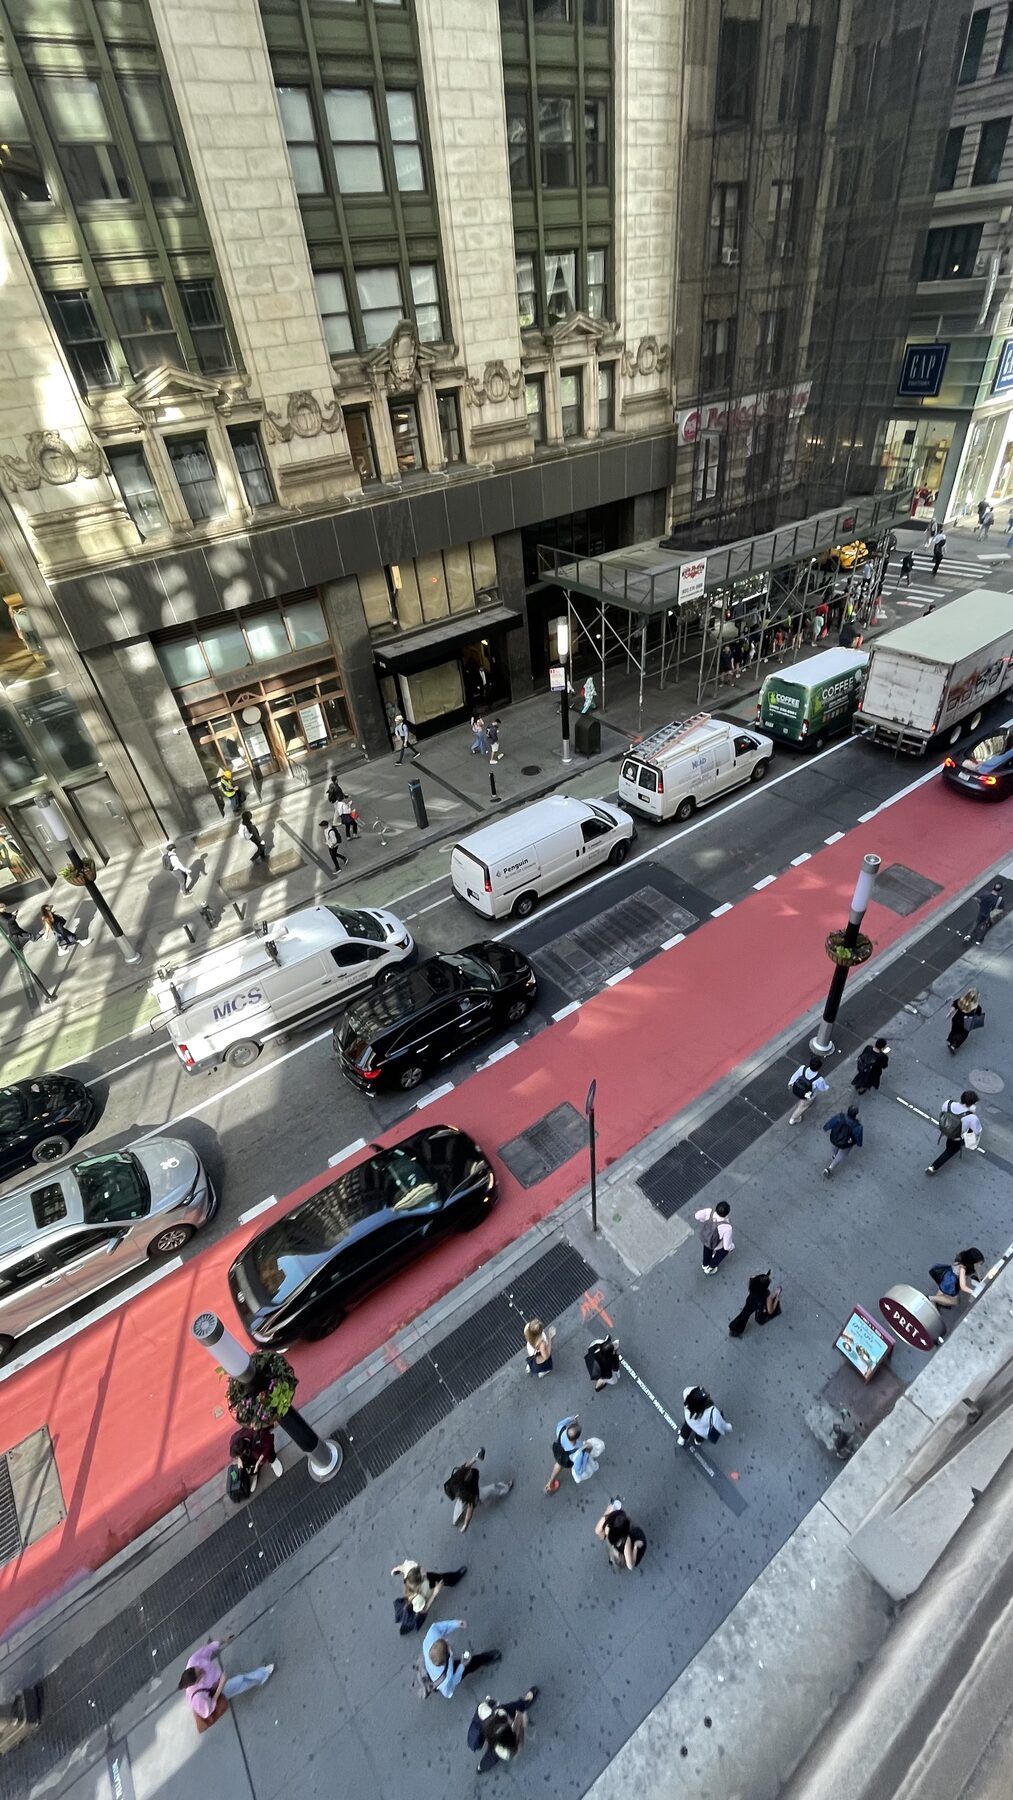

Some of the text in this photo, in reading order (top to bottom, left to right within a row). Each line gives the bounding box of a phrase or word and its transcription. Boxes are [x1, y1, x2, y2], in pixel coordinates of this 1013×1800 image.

[910, 354, 937, 379] GAP
[776, 693, 800, 707] COFFEE
[822, 677, 854, 700] COFFEE
[503, 858, 529, 874] Penguin
[213, 987, 262, 1023] MCS
[893, 1311, 919, 1337] PRET
